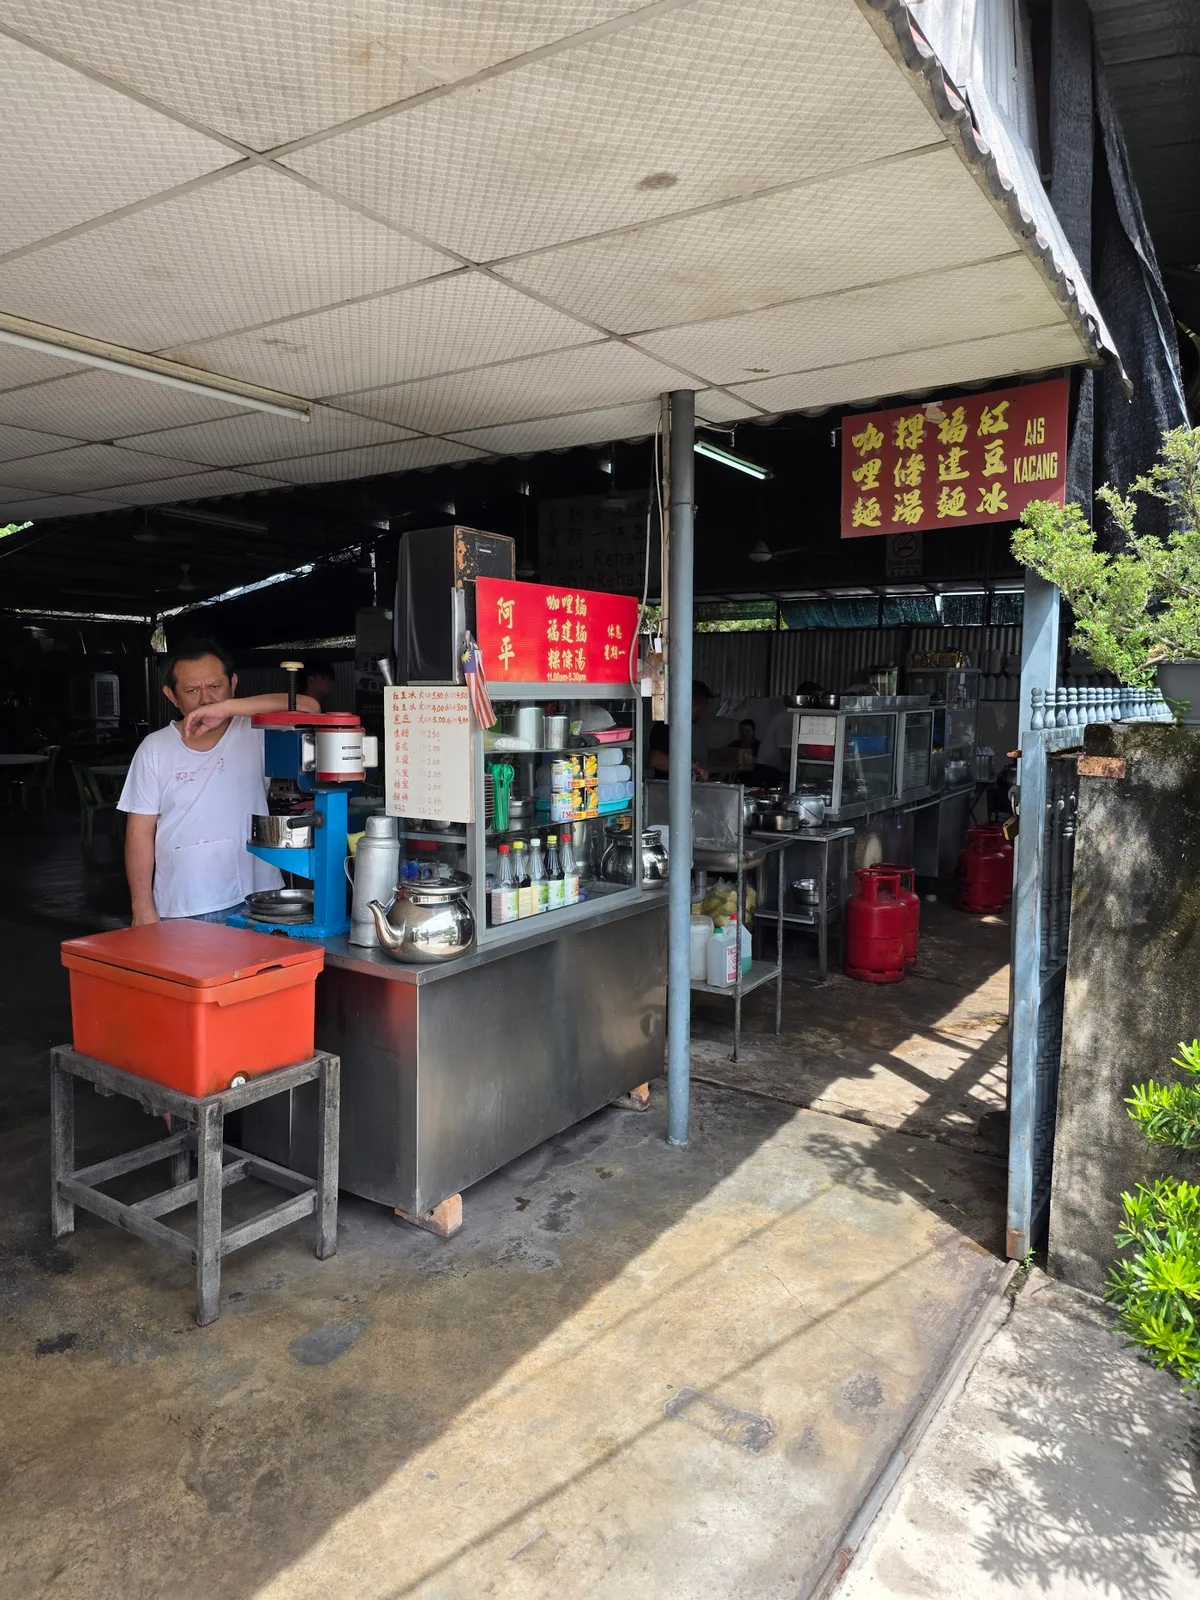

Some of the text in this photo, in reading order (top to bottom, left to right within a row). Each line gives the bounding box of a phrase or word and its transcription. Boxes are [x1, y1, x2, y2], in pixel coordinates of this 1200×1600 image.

[1024, 417, 1045, 447] AIS
[976, 400, 1010, 515] 紅豆冰
[1013, 452, 1058, 484] KACANG
[497, 597, 516, 671] 阿平
[607, 624, 622, 639] 休息
[604, 644, 625, 660] 星期一
